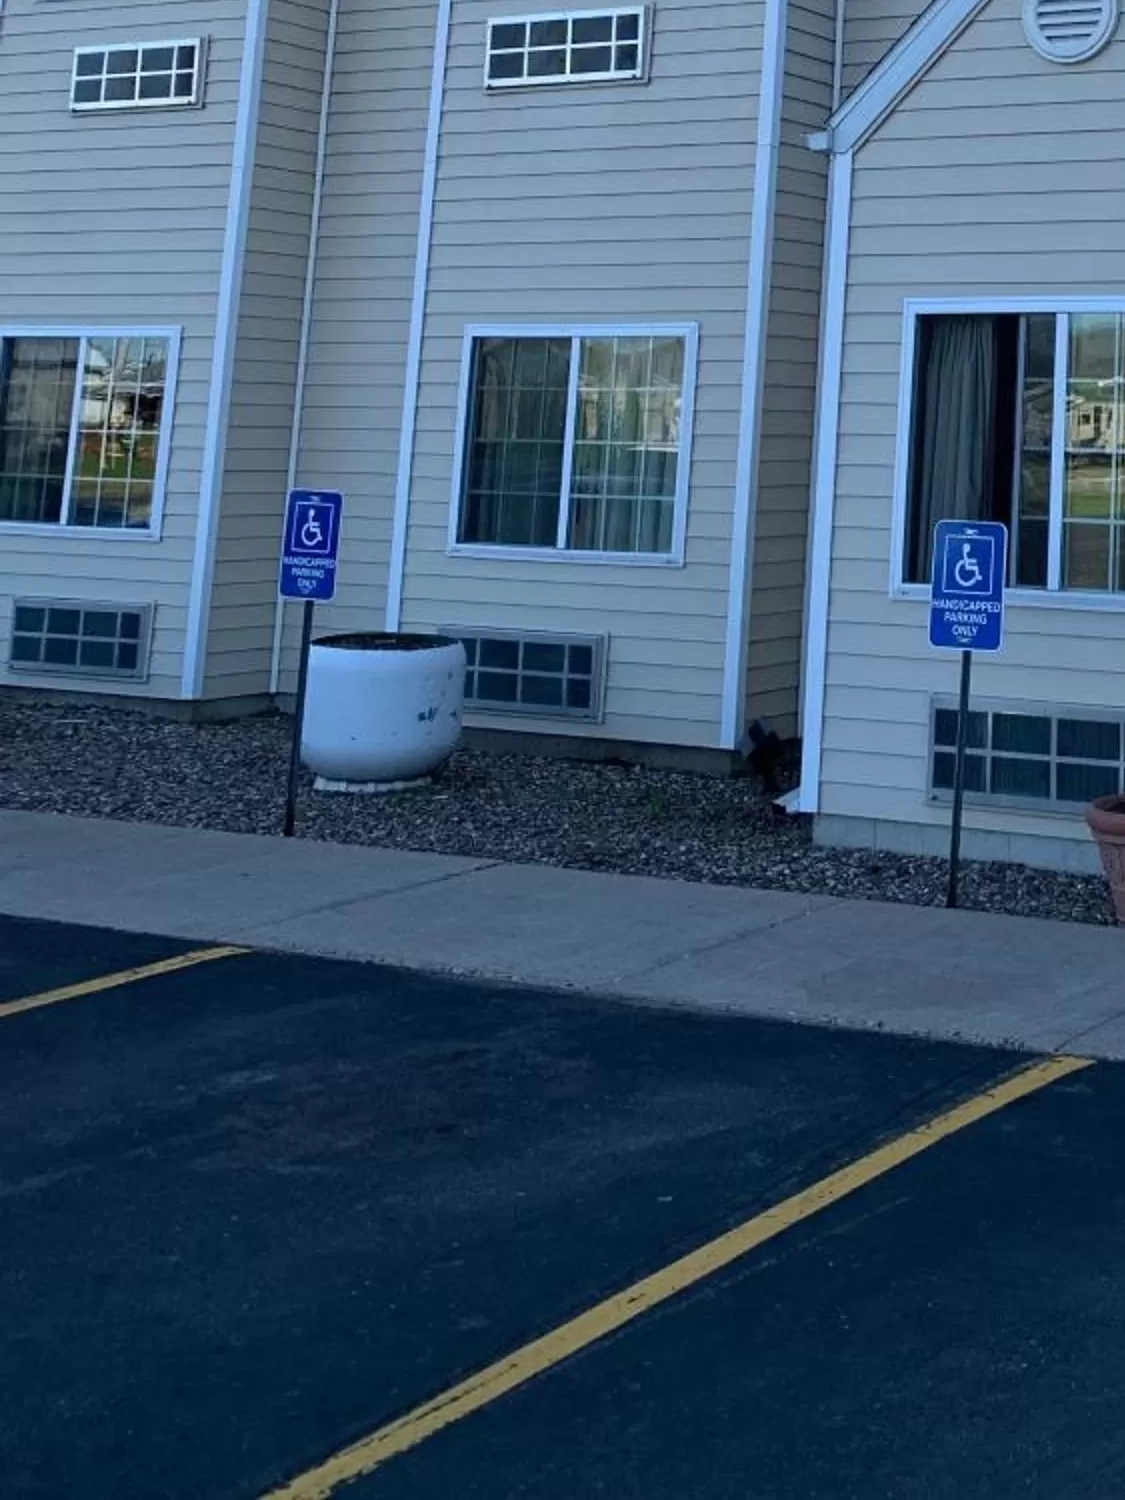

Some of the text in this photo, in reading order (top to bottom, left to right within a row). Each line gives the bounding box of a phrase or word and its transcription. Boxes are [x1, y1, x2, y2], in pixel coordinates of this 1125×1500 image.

[933, 598, 1001, 613] HANDICAPPED
[943, 611, 988, 625] PARKING
[951, 625, 979, 637] ONLY
